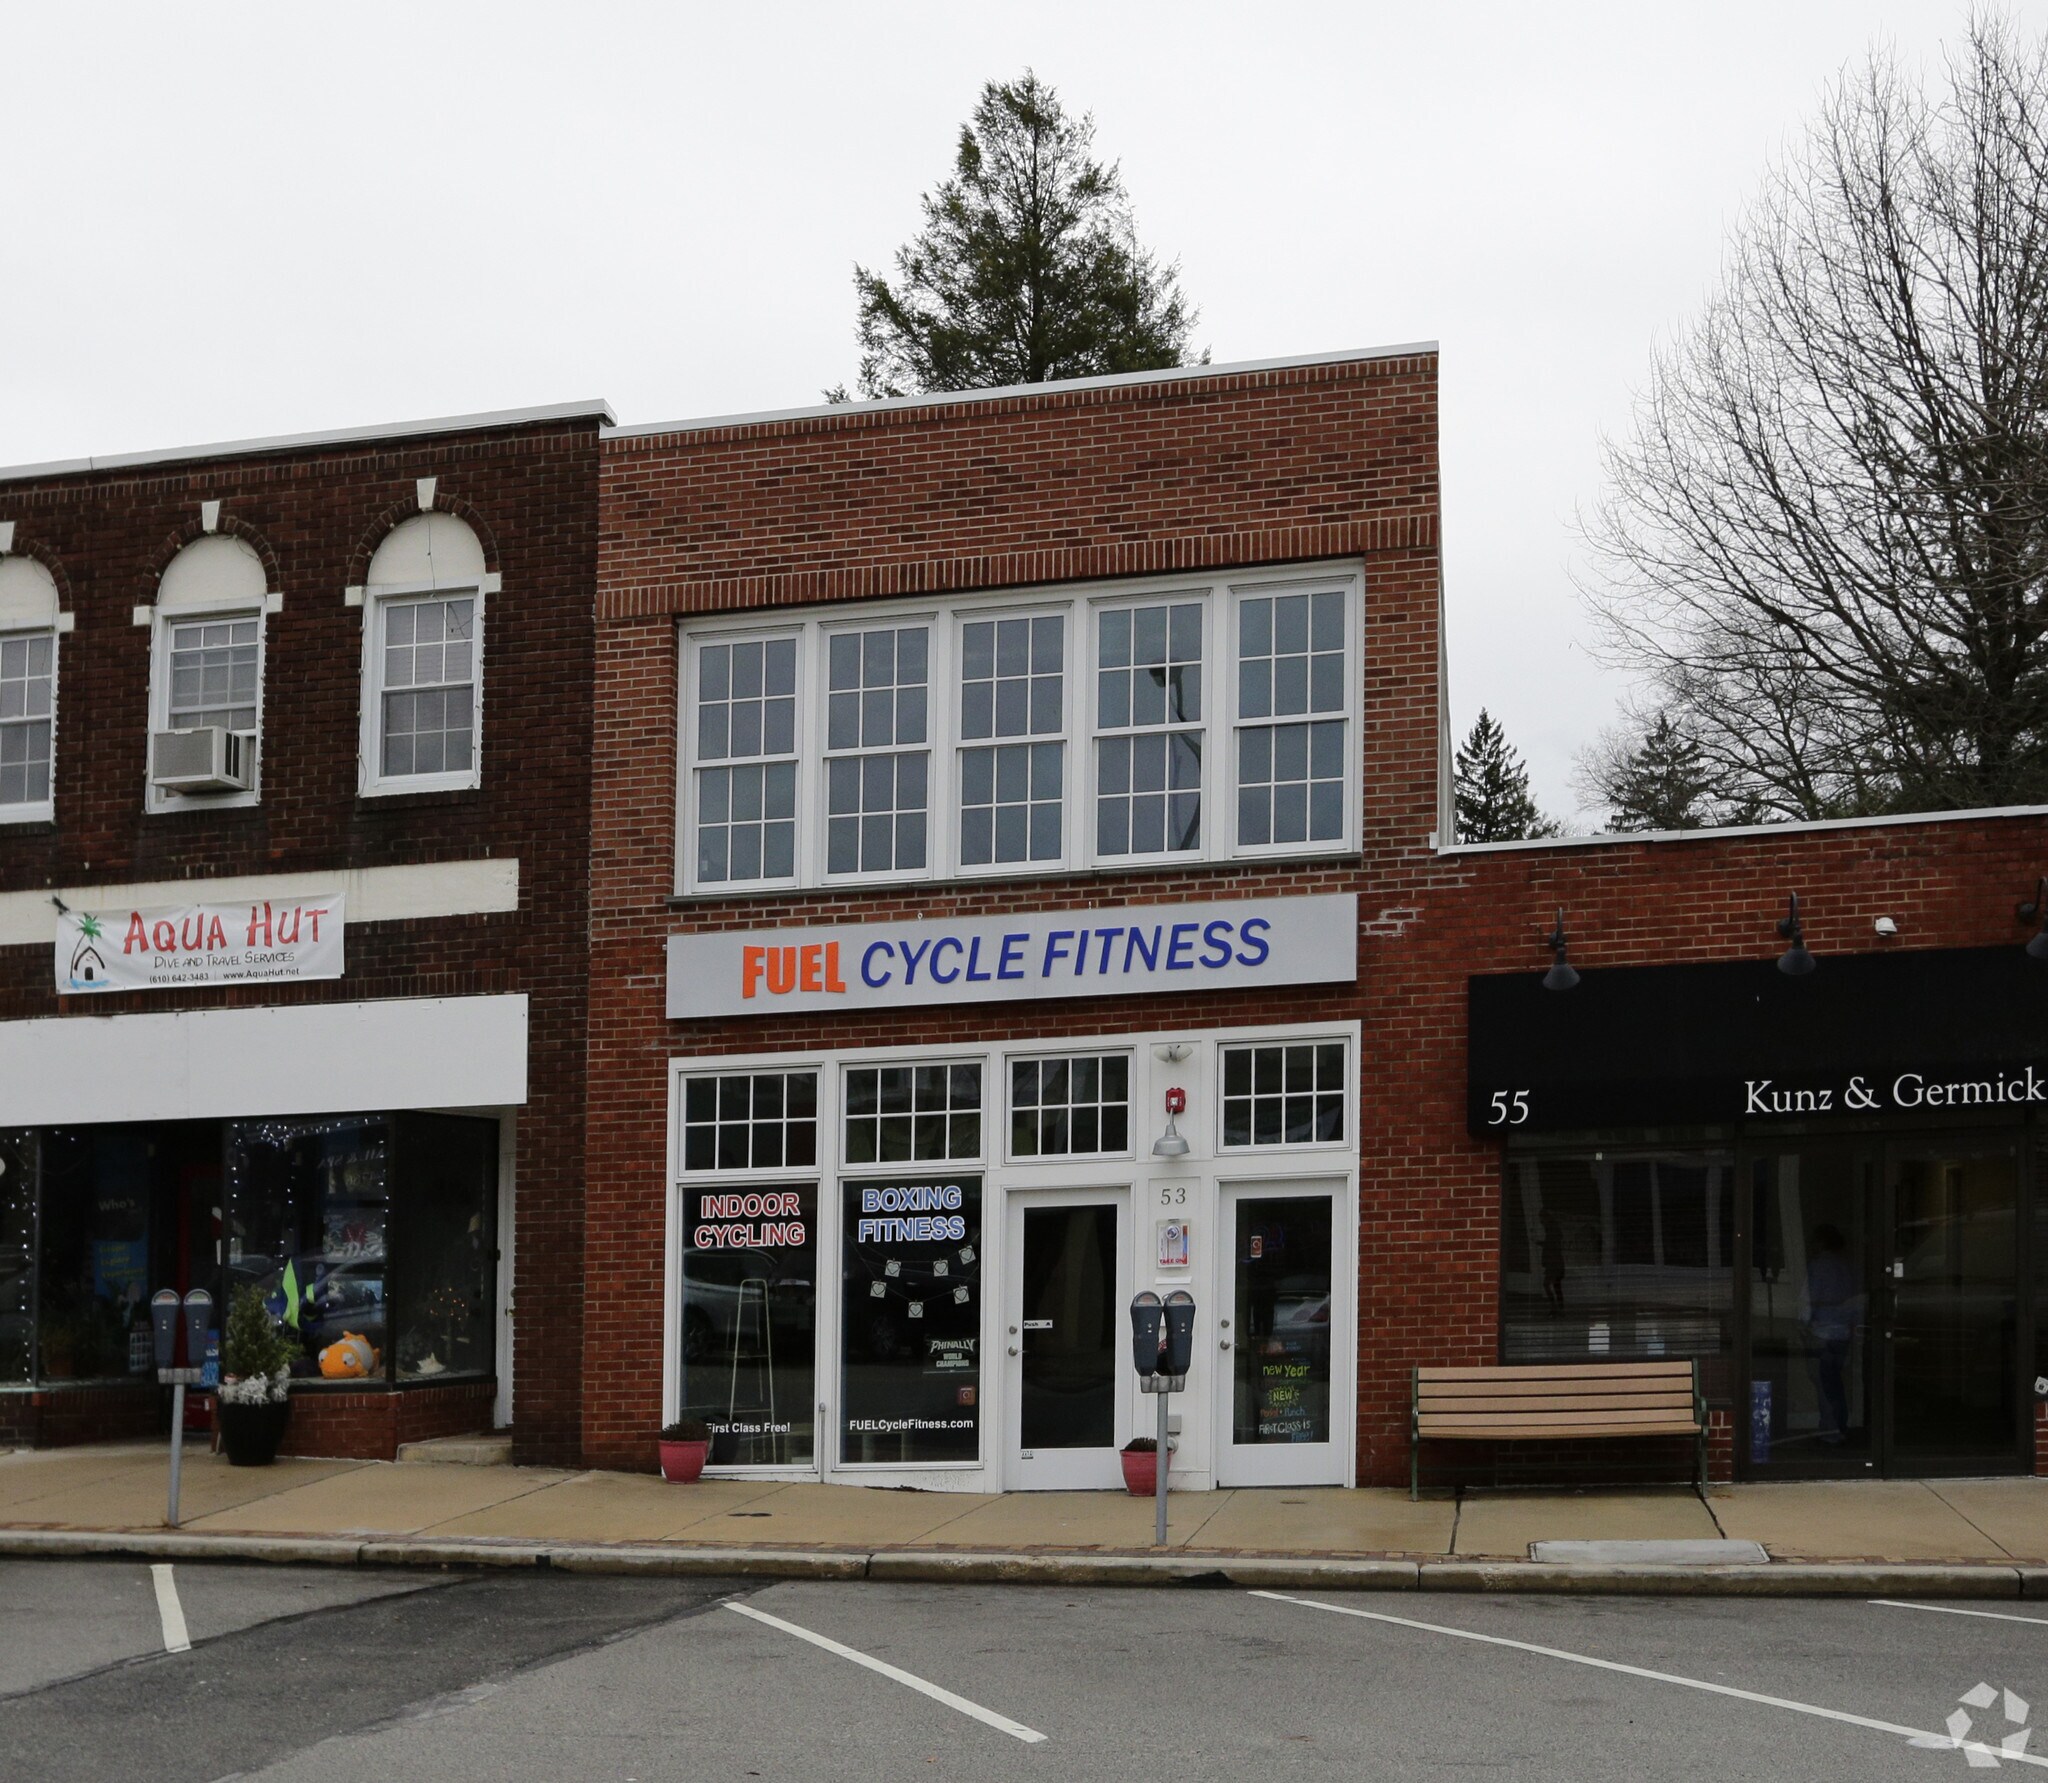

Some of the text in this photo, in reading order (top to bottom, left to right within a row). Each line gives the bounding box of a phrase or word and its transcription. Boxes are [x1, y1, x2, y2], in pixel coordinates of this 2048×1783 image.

[123, 901, 328, 954] AQUA HUT
[154, 951, 295, 969] DIVE AND TRAVEL SERVICES
[742, 917, 1271, 999] FUEL CYCLE FITNESS
[149, 968, 299, 984] (610) 642-3483 www.AquaHut.net
[1745, 1066, 2046, 1114] Kunz & Germick
[1488, 1089, 1530, 1125] 55
[701, 1193, 800, 1219] INDOOR
[862, 1185, 962, 1212] BOXING
[1161, 1187, 1186, 1205] 53
[694, 1221, 805, 1248] CYCLING
[858, 1215, 965, 1243] FITNESS
[930, 1339, 976, 1354] PHINALLY
[1263, 1365, 1282, 1376] new
[1273, 1390, 1293, 1401] NEW
[732, 1422, 761, 1433] Class
[763, 1422, 791, 1433] Free!
[849, 1418, 973, 1432] FUELCycleFitness.com
